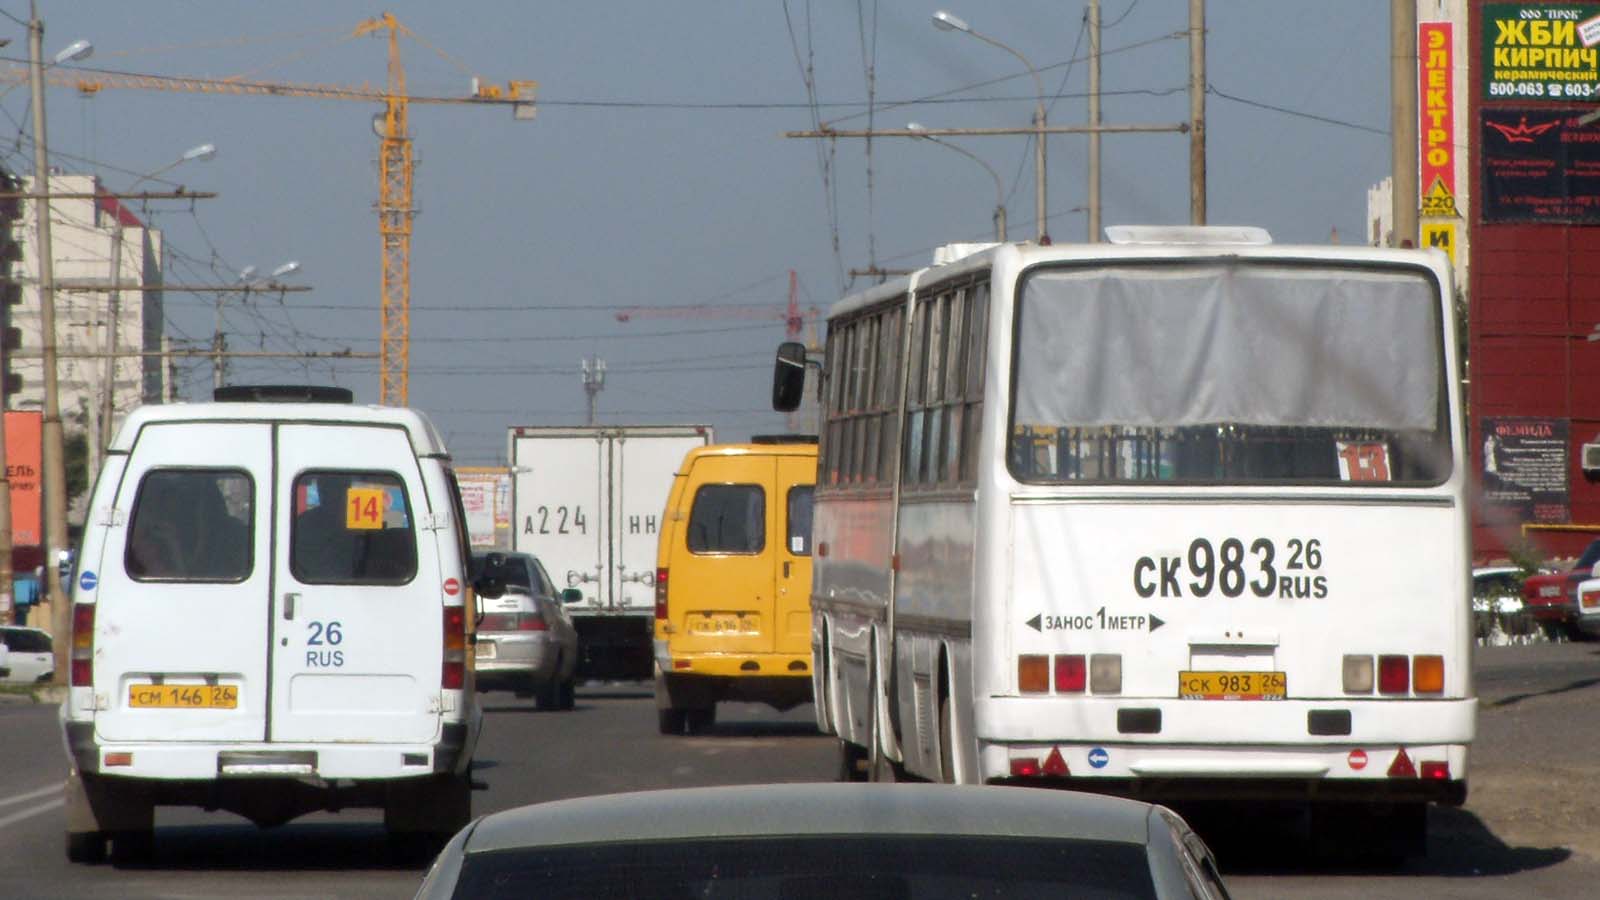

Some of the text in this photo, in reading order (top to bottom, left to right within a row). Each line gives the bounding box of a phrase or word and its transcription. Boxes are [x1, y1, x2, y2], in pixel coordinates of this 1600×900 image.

[1495, 20, 1575, 46] ЖБИ
[1494, 47, 1597, 69] КИРПИЧ
[1494, 69, 1598, 81] керамический
[1426, 30, 1449, 167] ЭЛЕКТРО
[1490, 82, 1544, 96] 500-063
[1422, 196, 1455, 209] 220
[352, 496, 379, 522] 14
[1286, 538, 1322, 570] 26
[1279, 576, 1328, 599] RUS
[1046, 615, 1093, 630] ЗАНОС
[306, 621, 343, 646] 26
[306, 651, 344, 667] RUS
[1218, 675, 1251, 692] 983
[1262, 674, 1280, 687] 26
[170, 688, 203, 705] 146
